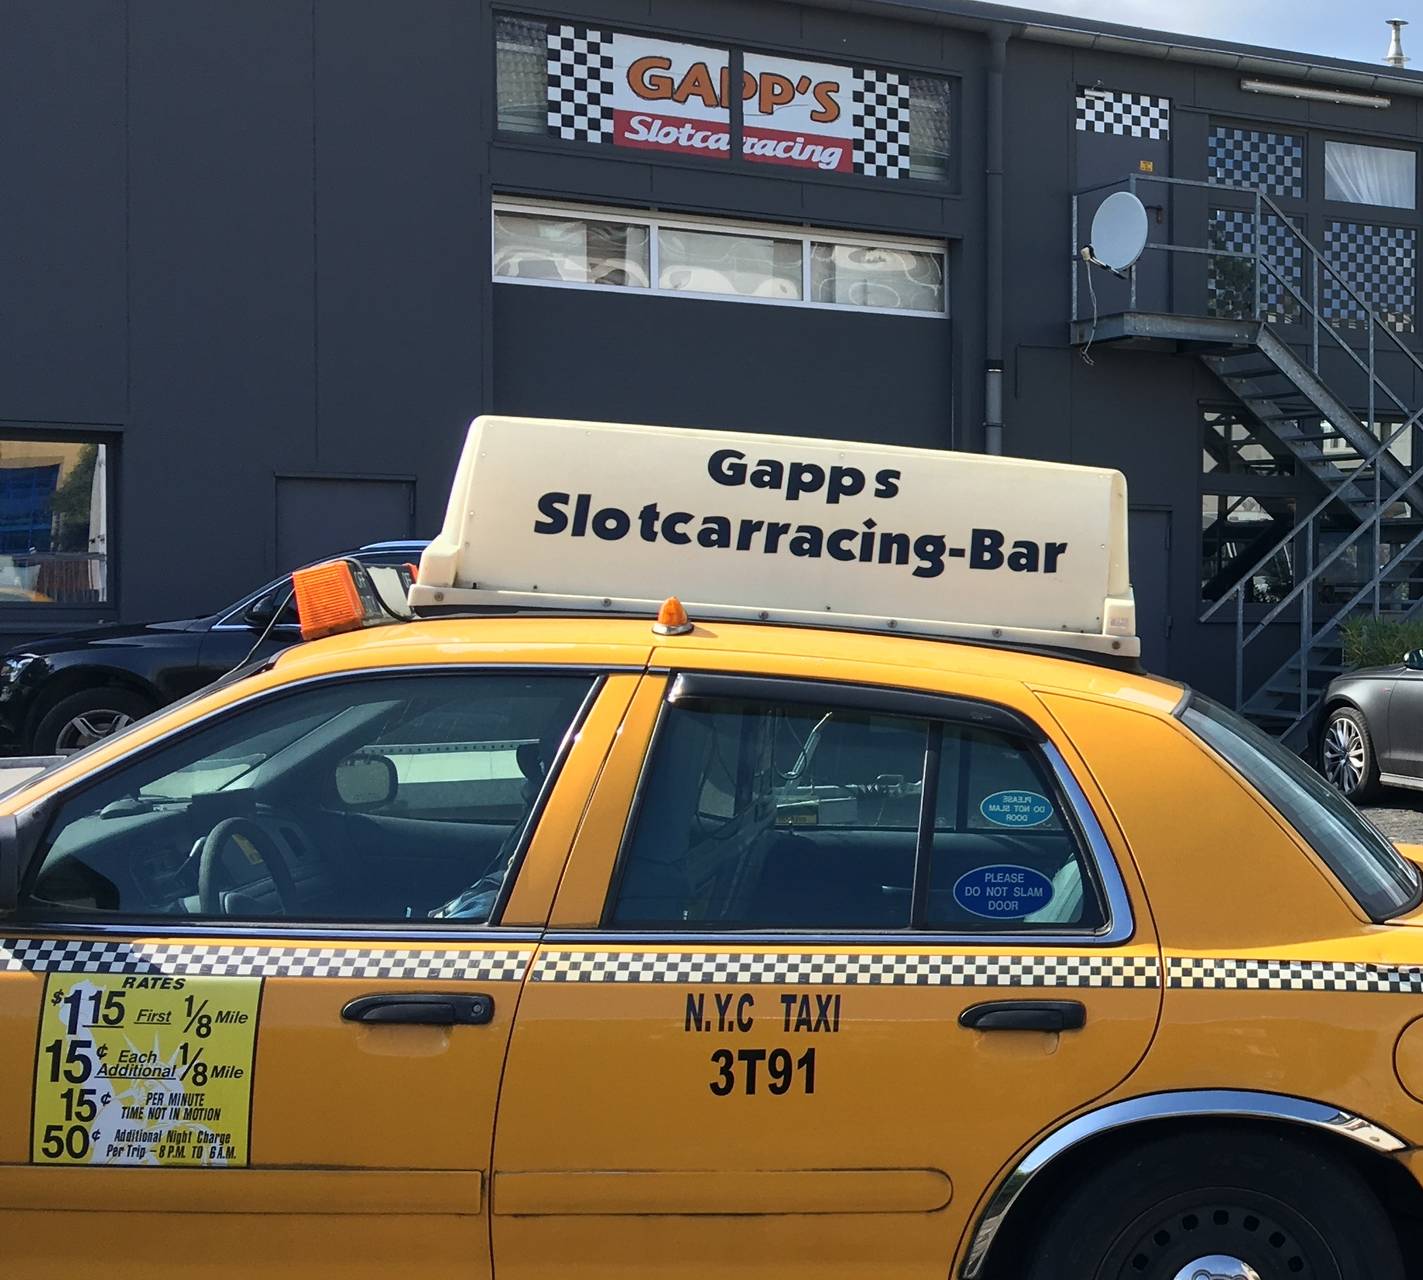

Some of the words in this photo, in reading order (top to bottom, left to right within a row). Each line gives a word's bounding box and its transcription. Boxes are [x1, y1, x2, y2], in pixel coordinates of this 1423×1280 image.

[627, 55, 841, 123] GAPP'S
[624, 115, 843, 170] Slotcaracing
[533, 490, 1068, 578] Slotcarracing-Bar
[984, 873, 1024, 883] PLEASE
[965, 886, 980, 897] DO
[986, 886, 1008, 897] NOT
[1013, 887, 1043, 897] SLAM
[988, 901, 1018, 911] DOOR
[122, 976, 186, 991] RATES
[136, 1009, 171, 1024] First
[215, 1010, 249, 1024] Mile
[780, 994, 841, 1033] TAXI
[97, 1063, 176, 1078] Additional
[118, 1050, 158, 1064] Each
[210, 1065, 244, 1079] Mile
[709, 1047, 816, 1097] 3T91
[146, 1092, 165, 1106] PER
[168, 1092, 206, 1107] MINUTE
[121, 1106, 144, 1120] TIME
[148, 1107, 168, 1120] NOT
[169, 1107, 180, 1120] IN
[183, 1108, 222, 1121] MOTION
[114, 1129, 162, 1143] Additional
[166, 1130, 192, 1144] Night
[197, 1130, 231, 1145] Charge
[106, 1144, 125, 1157] Per
[126, 1144, 146, 1160] Trip
[191, 1146, 203, 1159] TO
